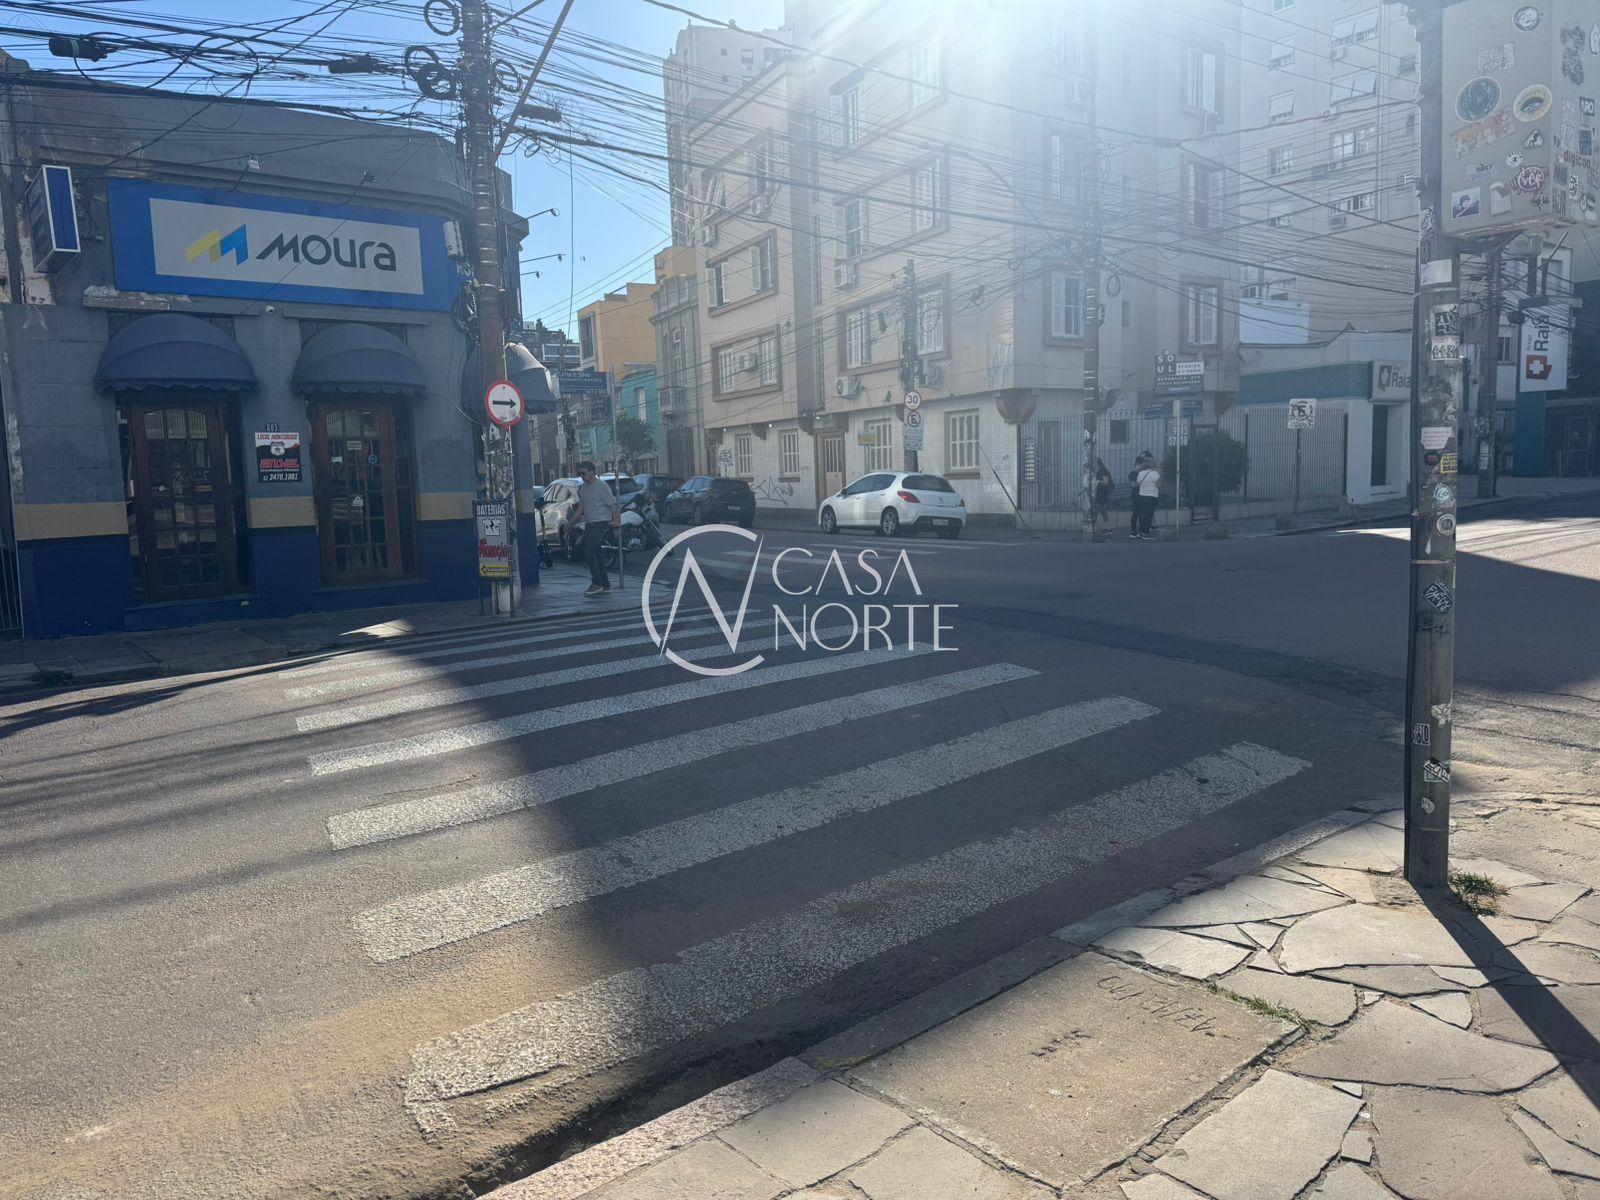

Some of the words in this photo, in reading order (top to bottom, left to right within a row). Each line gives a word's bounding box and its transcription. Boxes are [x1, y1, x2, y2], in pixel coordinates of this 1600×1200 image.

[1533, 315, 1550, 351] Raia
[907, 395, 919, 404] 30
[476, 504, 506, 516] BATERIAS
